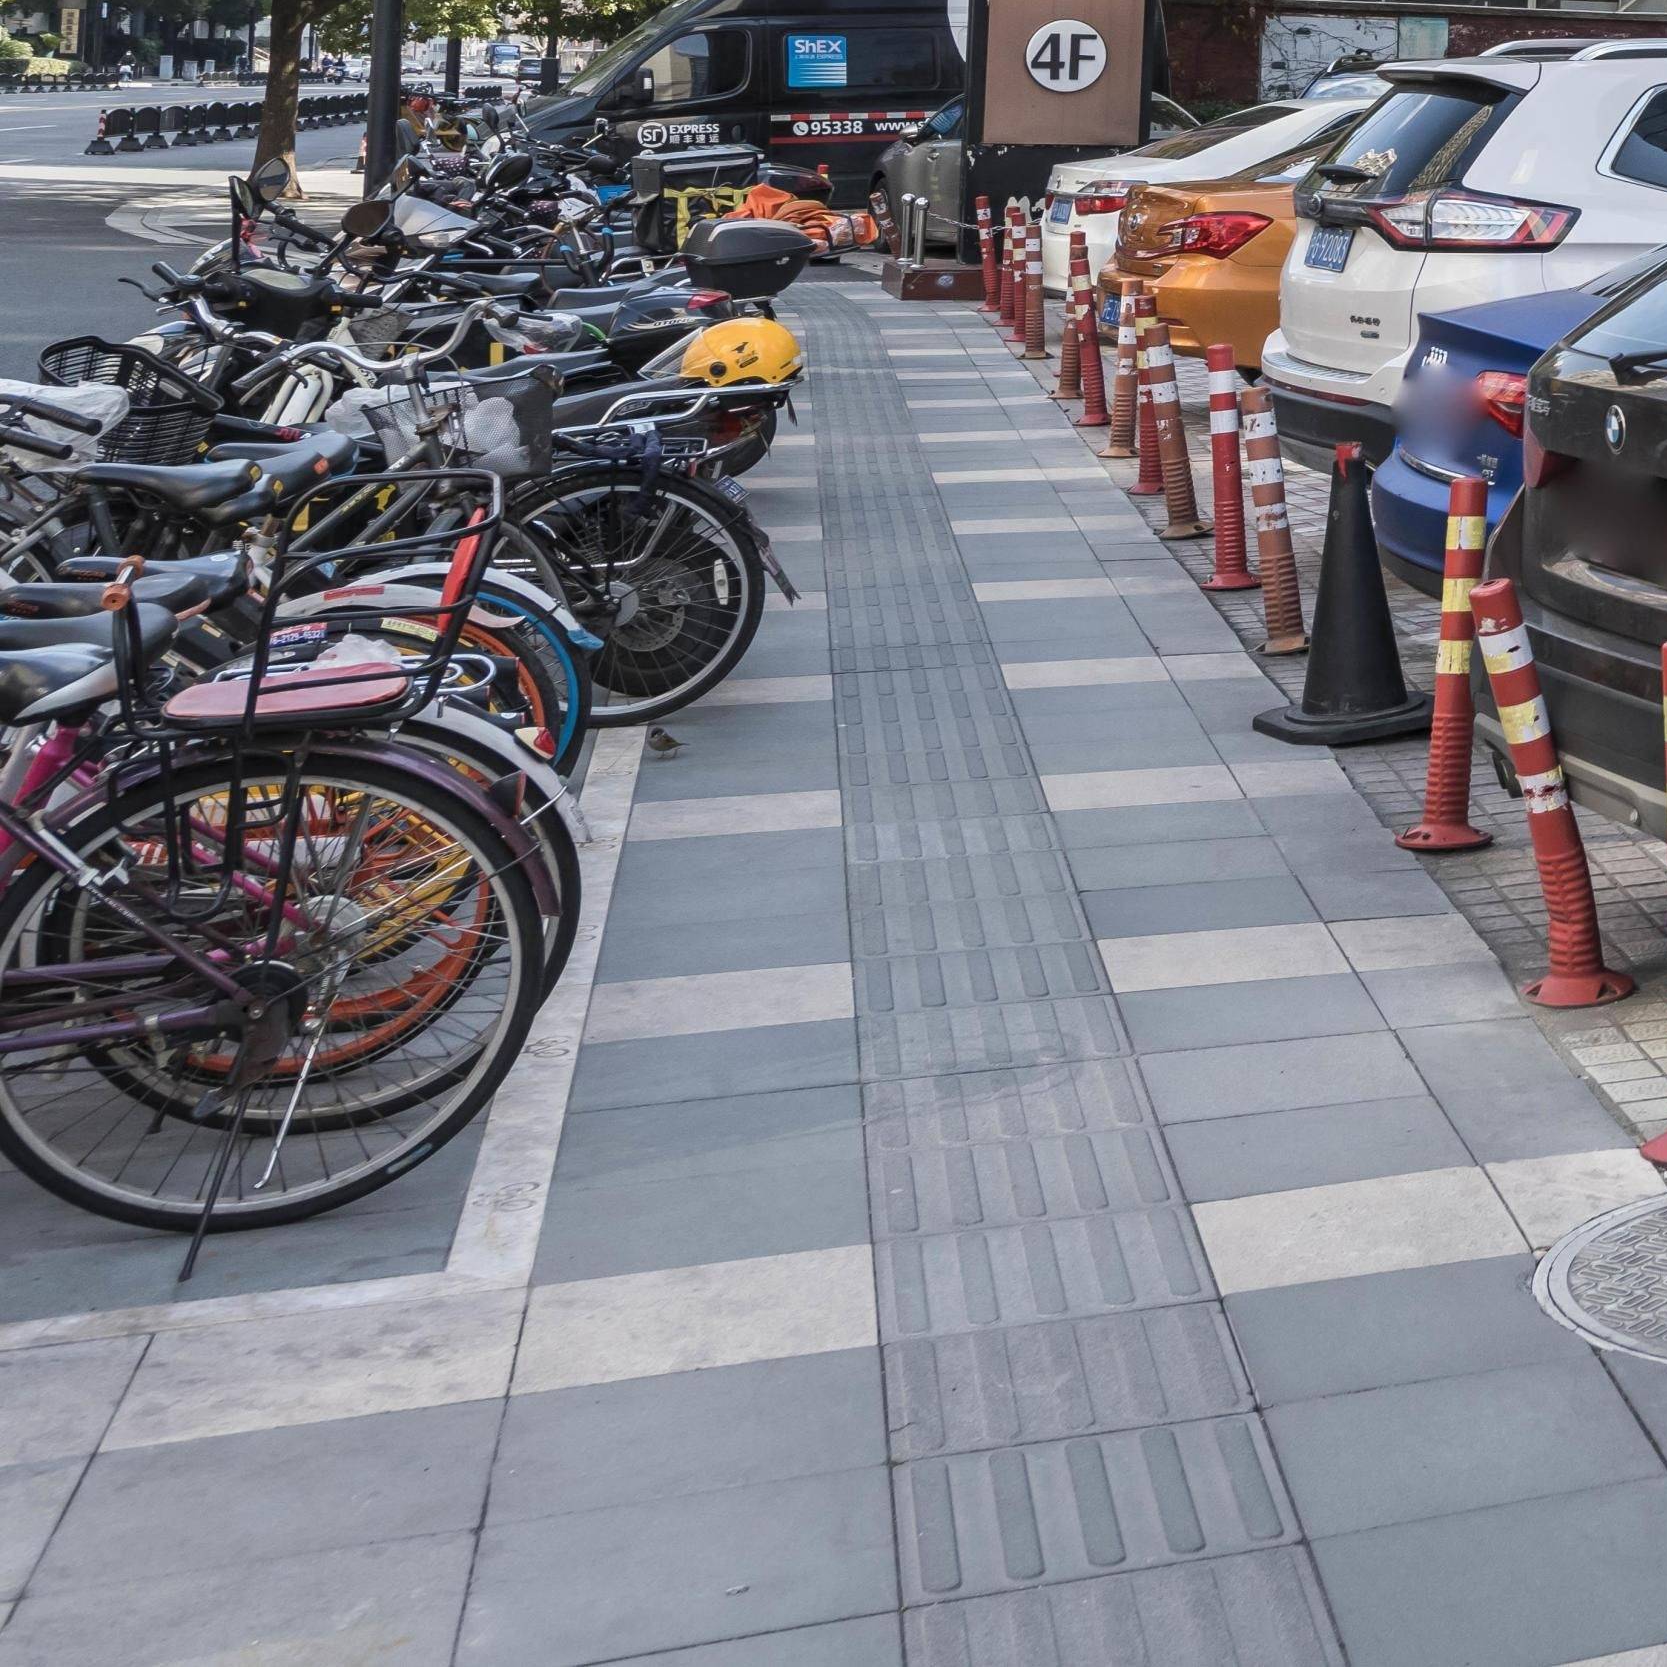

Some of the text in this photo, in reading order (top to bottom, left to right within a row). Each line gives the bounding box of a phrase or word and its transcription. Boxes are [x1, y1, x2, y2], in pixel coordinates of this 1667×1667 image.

[795, 39, 842, 54] ShEX
[1030, 32, 1097, 82] 4F
[669, 123, 720, 135] EXPRESS
[810, 120, 863, 135] 95338
